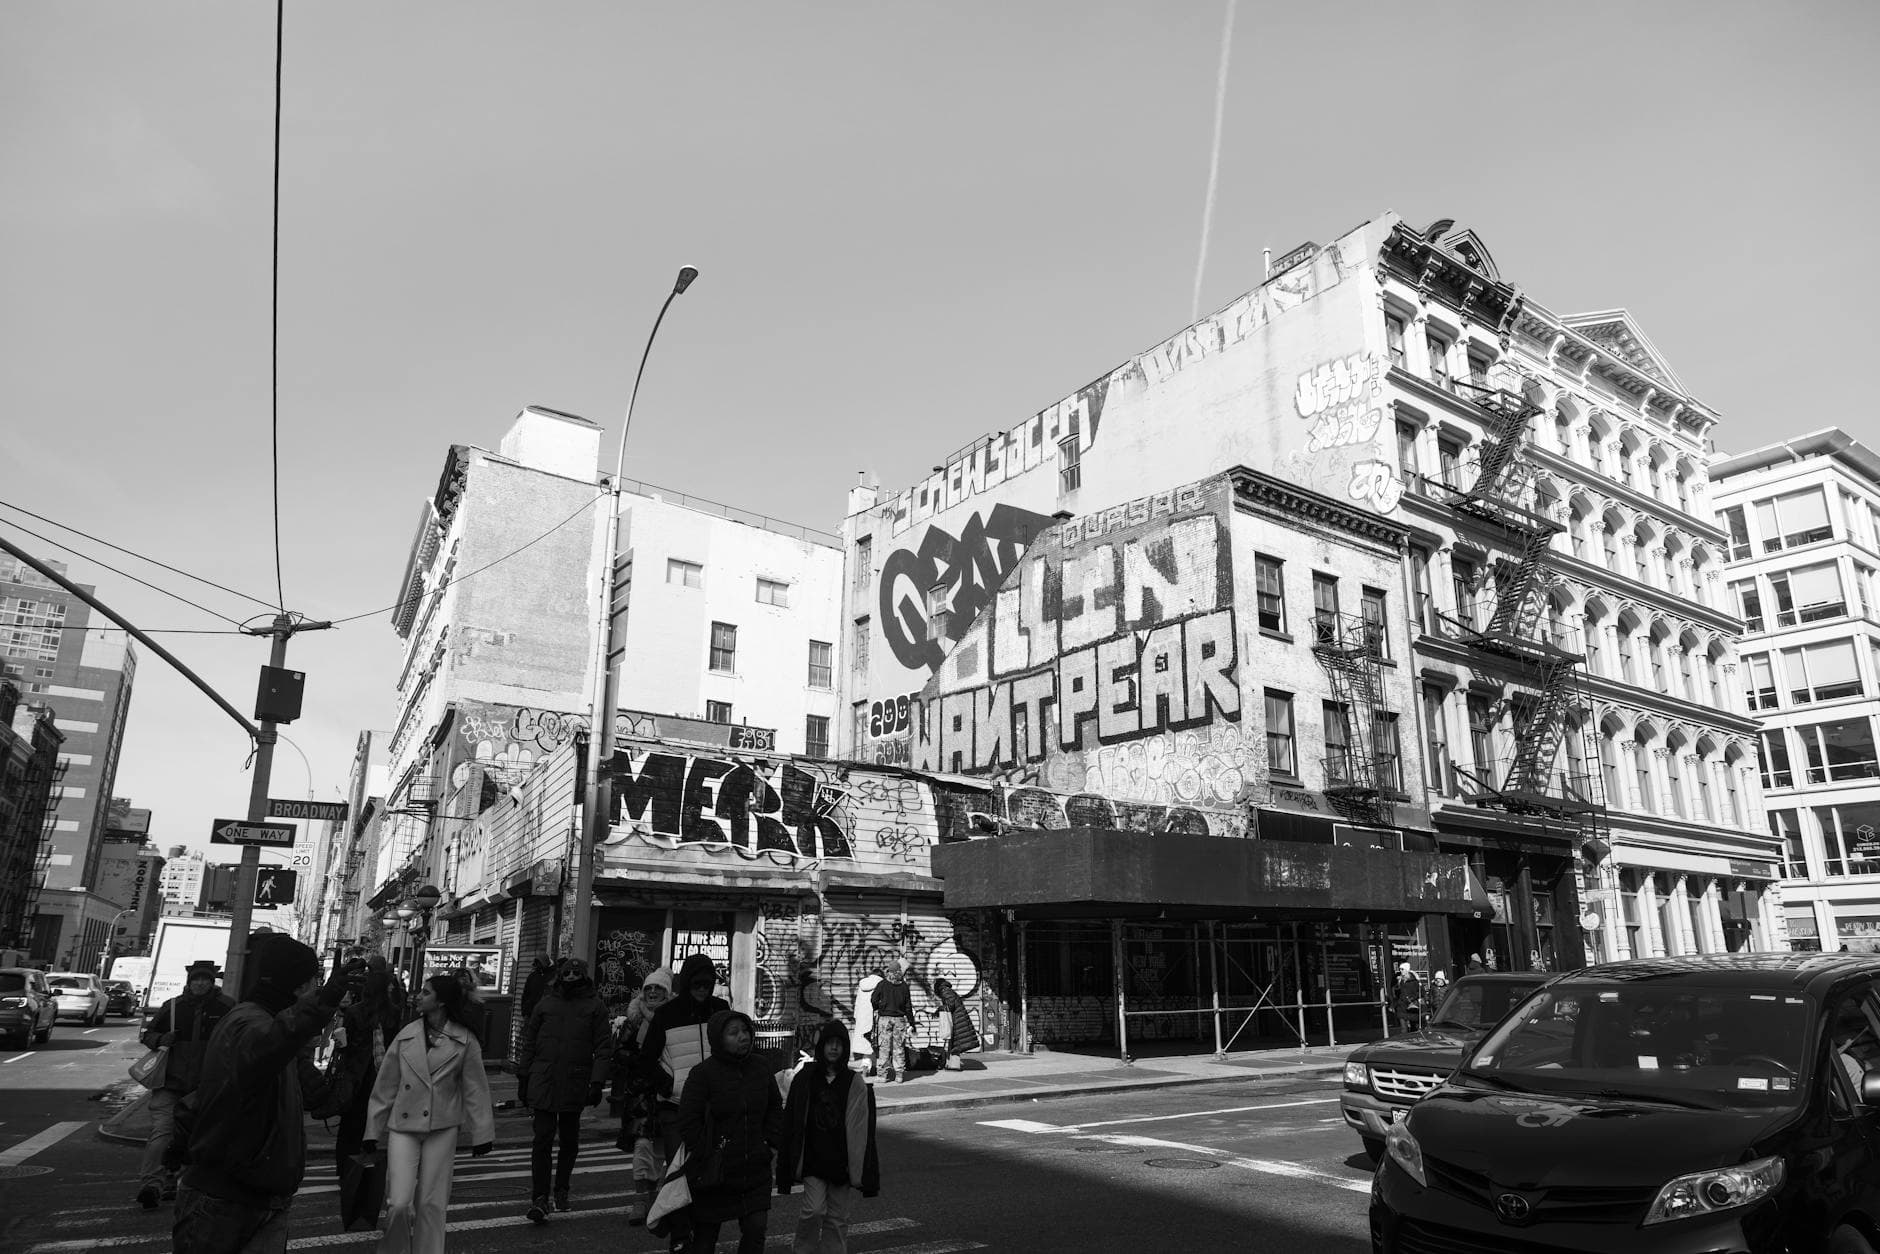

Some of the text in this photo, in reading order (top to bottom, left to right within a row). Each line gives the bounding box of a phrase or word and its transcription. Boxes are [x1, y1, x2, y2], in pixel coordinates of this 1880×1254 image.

[274, 802, 344, 819] BROADWAY
[225, 827, 285, 840] ONE WAY
[293, 855, 311, 866] 20
[677, 930, 727, 945] MY WIFE SAYS
[449, 953, 464, 962] Not
[674, 945, 728, 959] IF I GO FISHING
[429, 960, 448, 968] Beer
[449, 960, 461, 968] Ad
